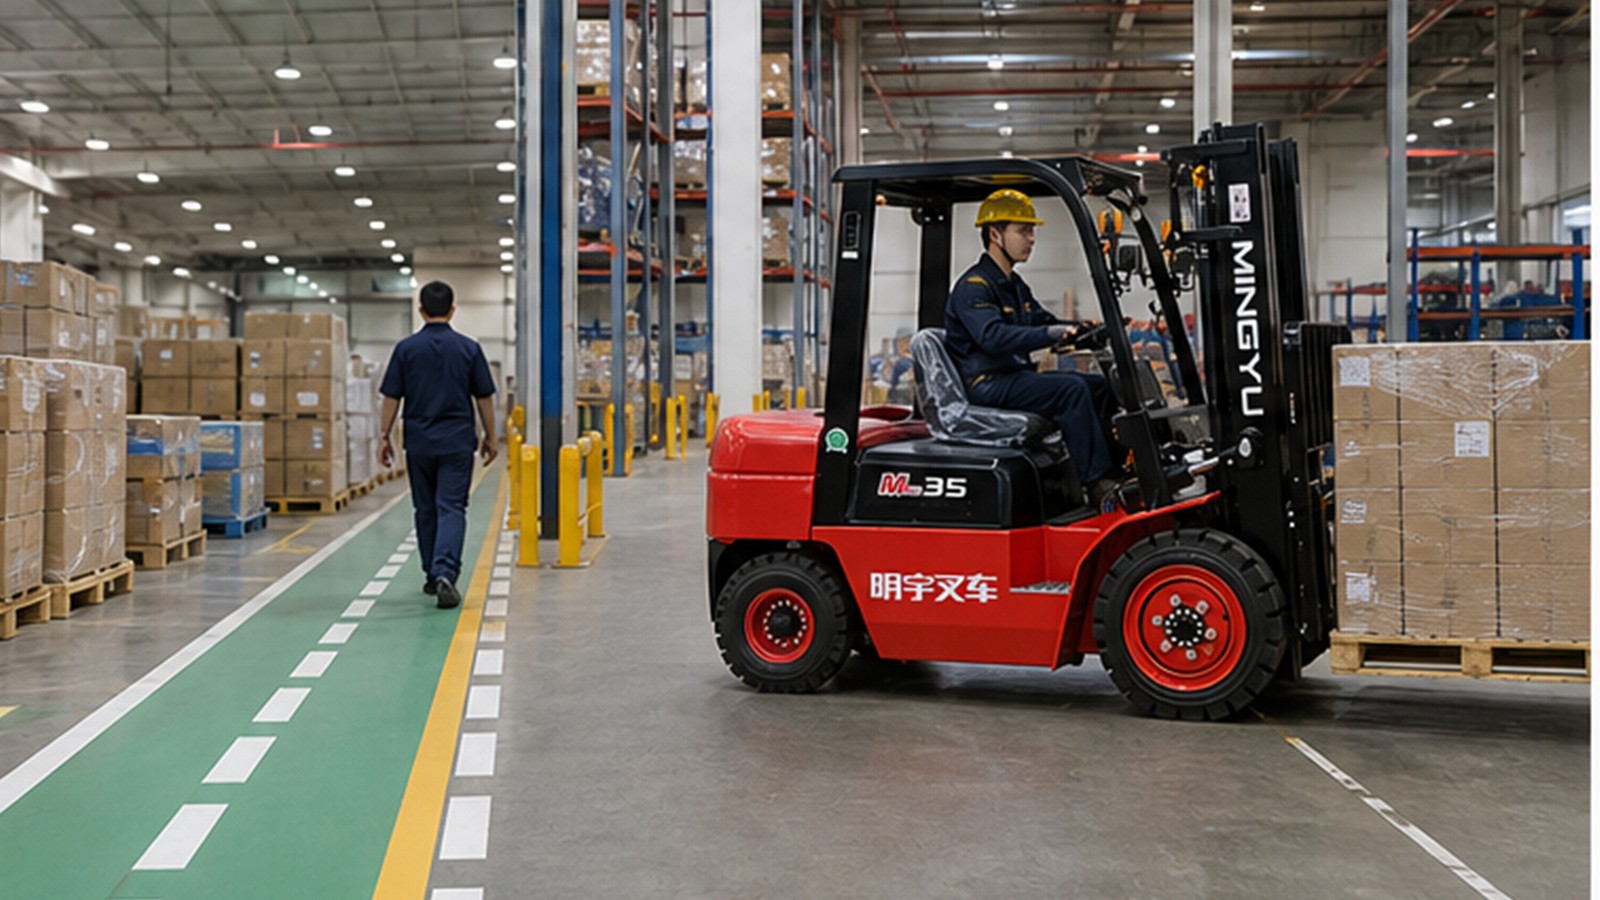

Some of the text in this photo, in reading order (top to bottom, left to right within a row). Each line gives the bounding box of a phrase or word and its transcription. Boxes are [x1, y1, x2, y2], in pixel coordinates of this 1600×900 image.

[1231, 240, 1265, 416] MINGYU
[923, 476, 967, 498] 35
[869, 572, 998, 604] 明宇叉车
